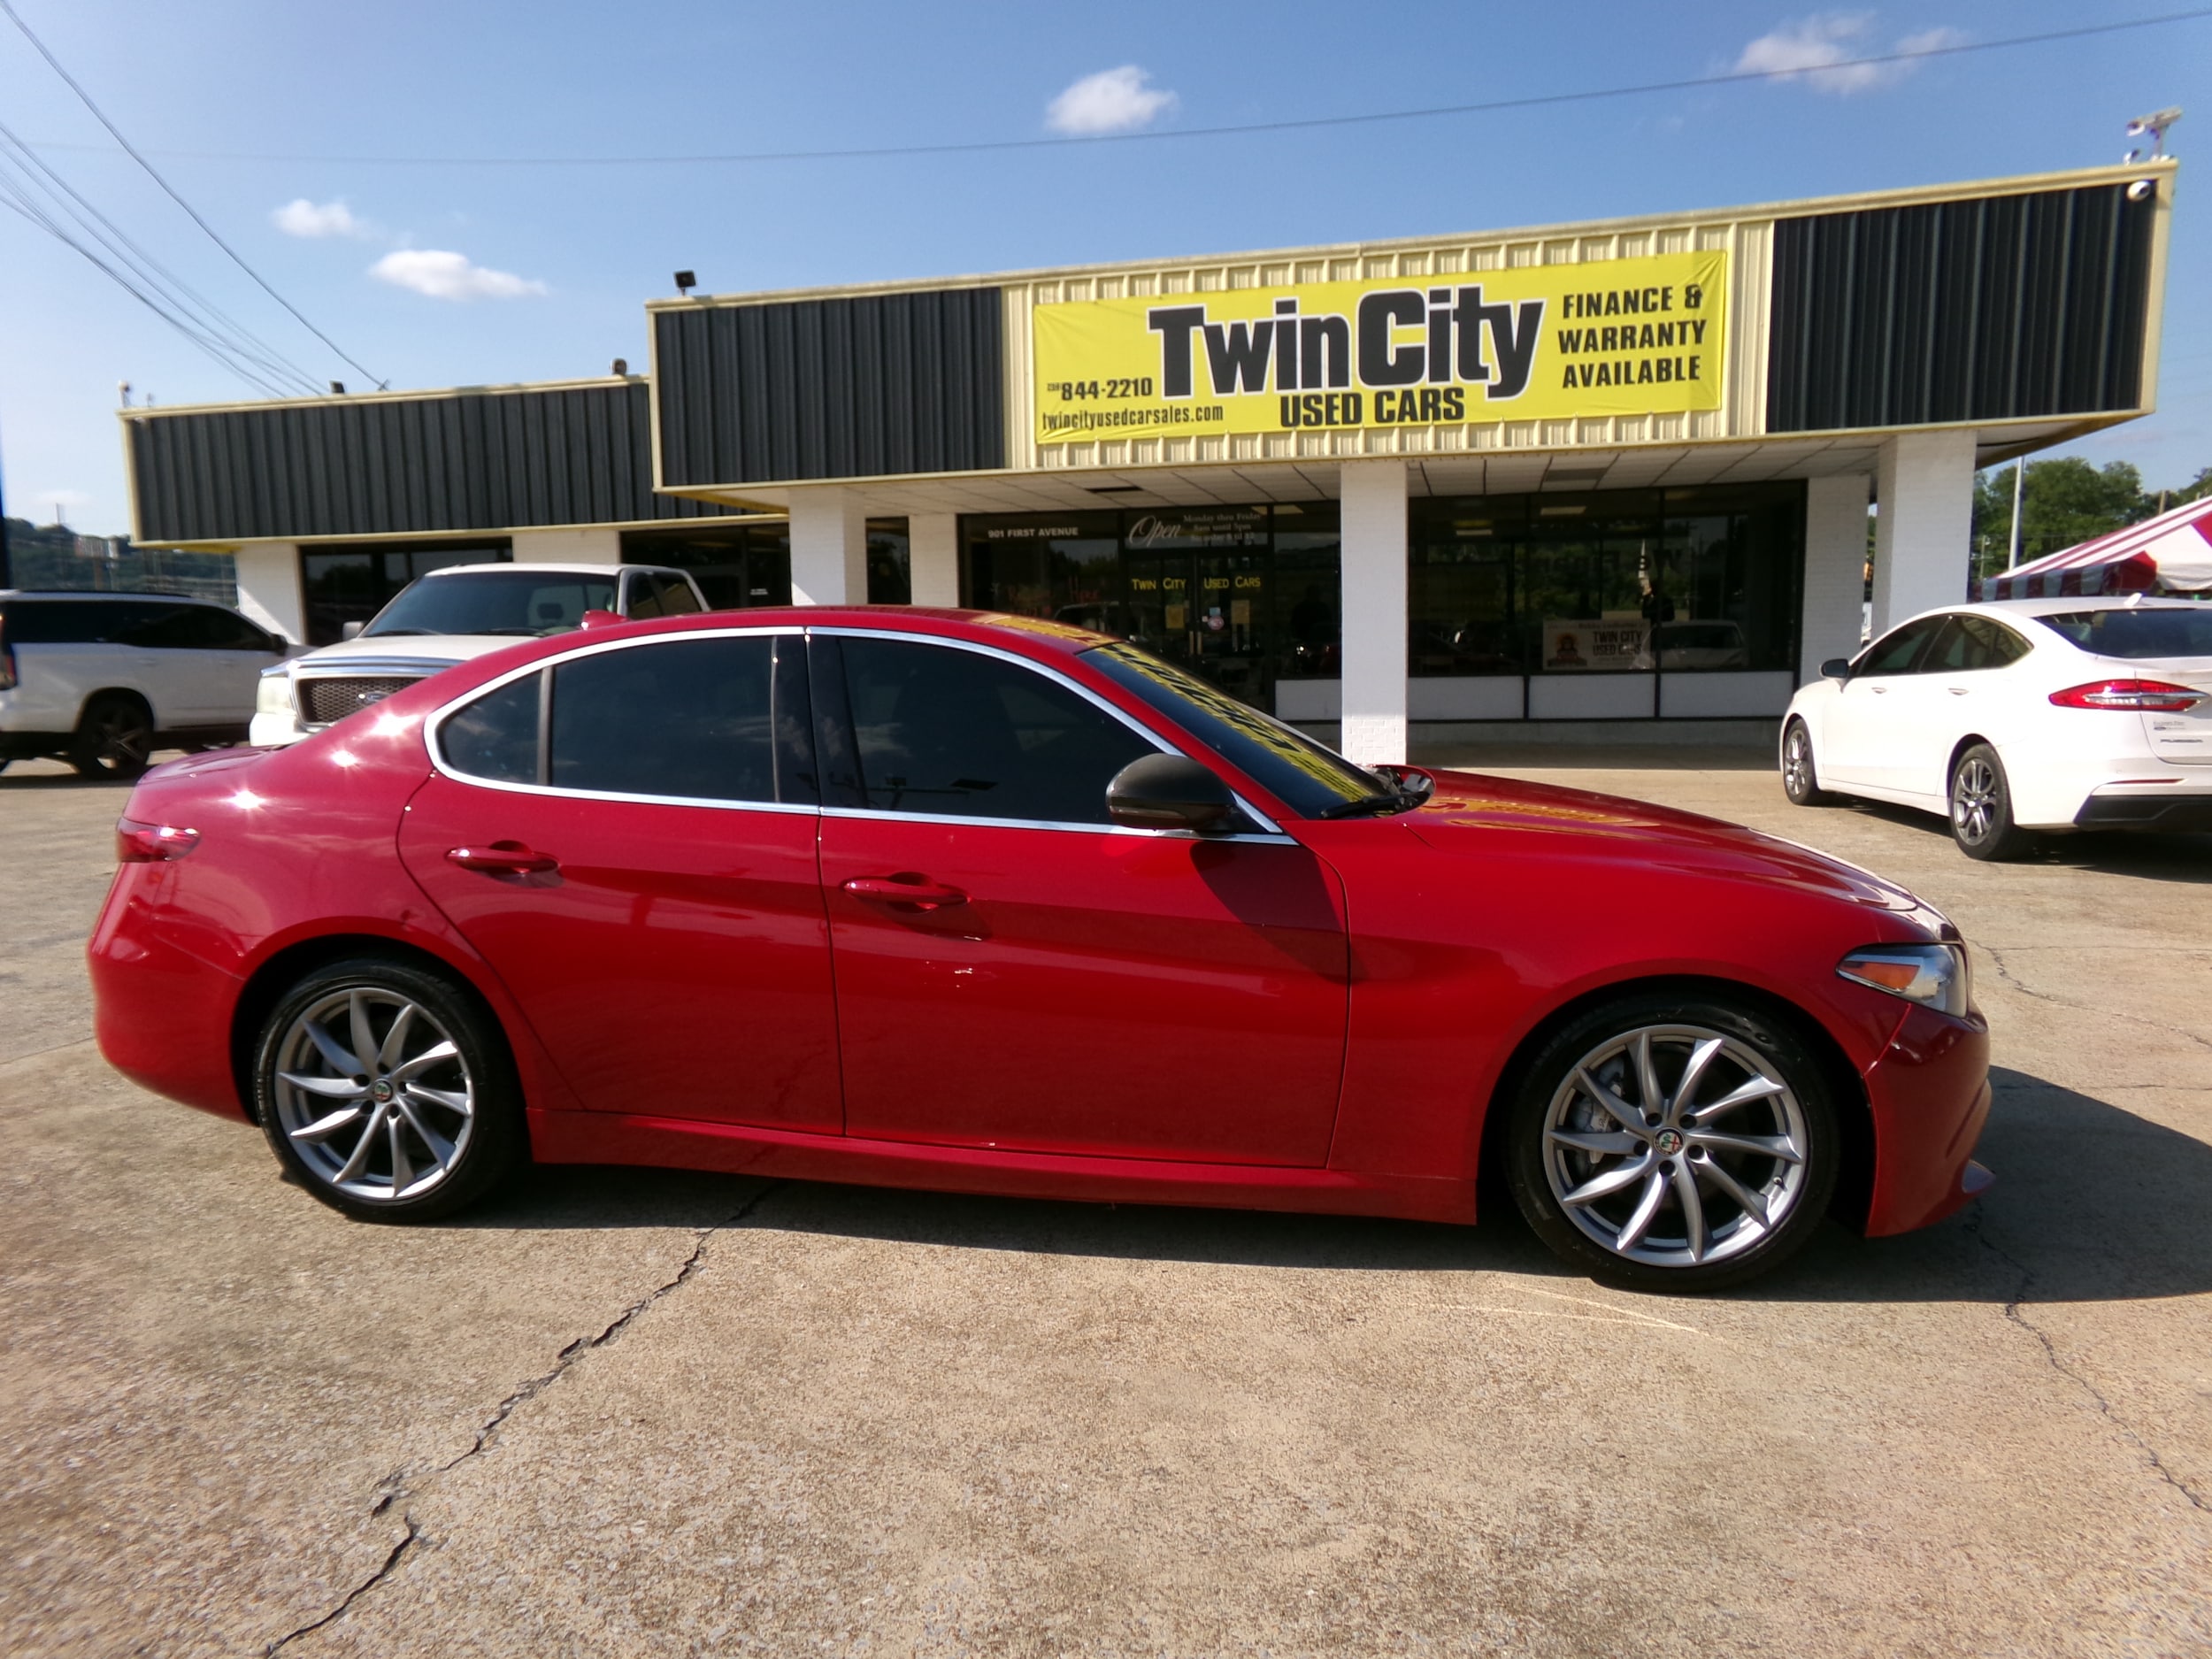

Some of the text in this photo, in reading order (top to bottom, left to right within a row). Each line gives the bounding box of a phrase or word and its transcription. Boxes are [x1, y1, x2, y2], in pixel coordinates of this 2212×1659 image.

[1563, 285, 1703, 319] FINANCE &
[1558, 319, 1706, 354] WARRANTY
[1563, 355, 1701, 388] AVAILABLE
[1043, 405, 1224, 430] twincityusedcarsales.com
[1280, 388, 1465, 428] USED CARS
[988, 526, 1079, 538] 901 FIRST AVENUE
[1129, 515, 1181, 548] Open
[1184, 514, 1214, 523] Monday
[1593, 629, 1643, 642] TWIN CITY
[1593, 644, 1617, 656] USED
